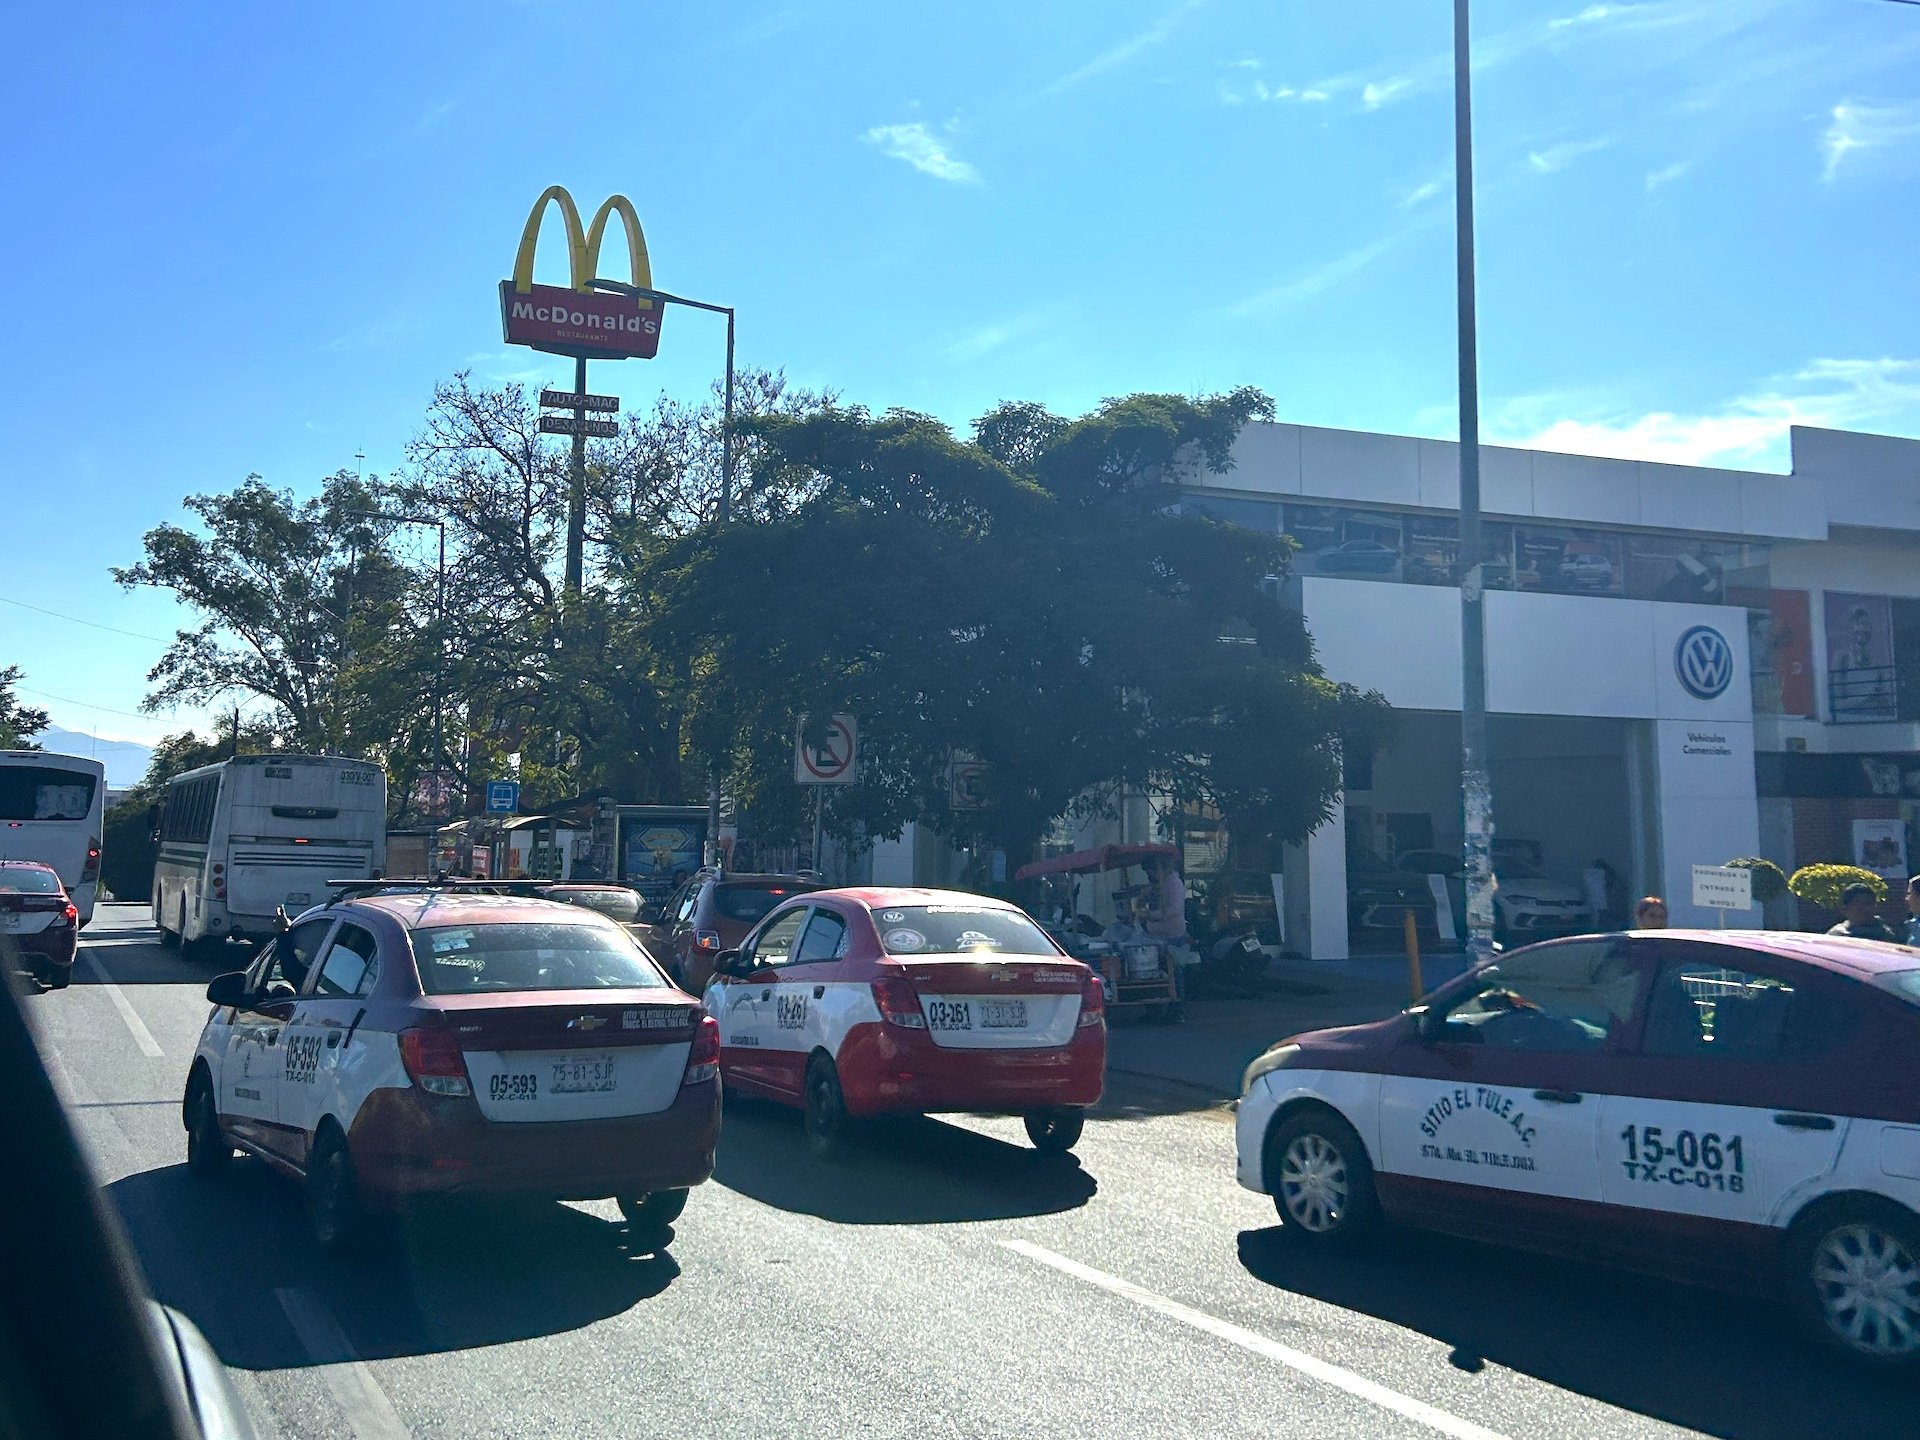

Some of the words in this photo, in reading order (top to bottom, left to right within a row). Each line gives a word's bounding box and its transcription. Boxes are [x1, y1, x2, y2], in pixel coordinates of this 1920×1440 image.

[512, 301, 657, 335] McDonald's
[547, 393, 617, 409] AUTO-MAC
[930, 1002, 970, 1022] 03-261
[286, 1035, 322, 1071] 05-593
[286, 1070, 316, 1084] TX-C-018
[490, 1074, 537, 1094] 05-593
[1421, 1096, 1453, 1138] SITIO
[1454, 1088, 1472, 1110] EL
[1477, 1087, 1514, 1119] TULE
[1621, 1124, 1744, 1174] 15-061
[1622, 1161, 1744, 1193] TX-C-018
